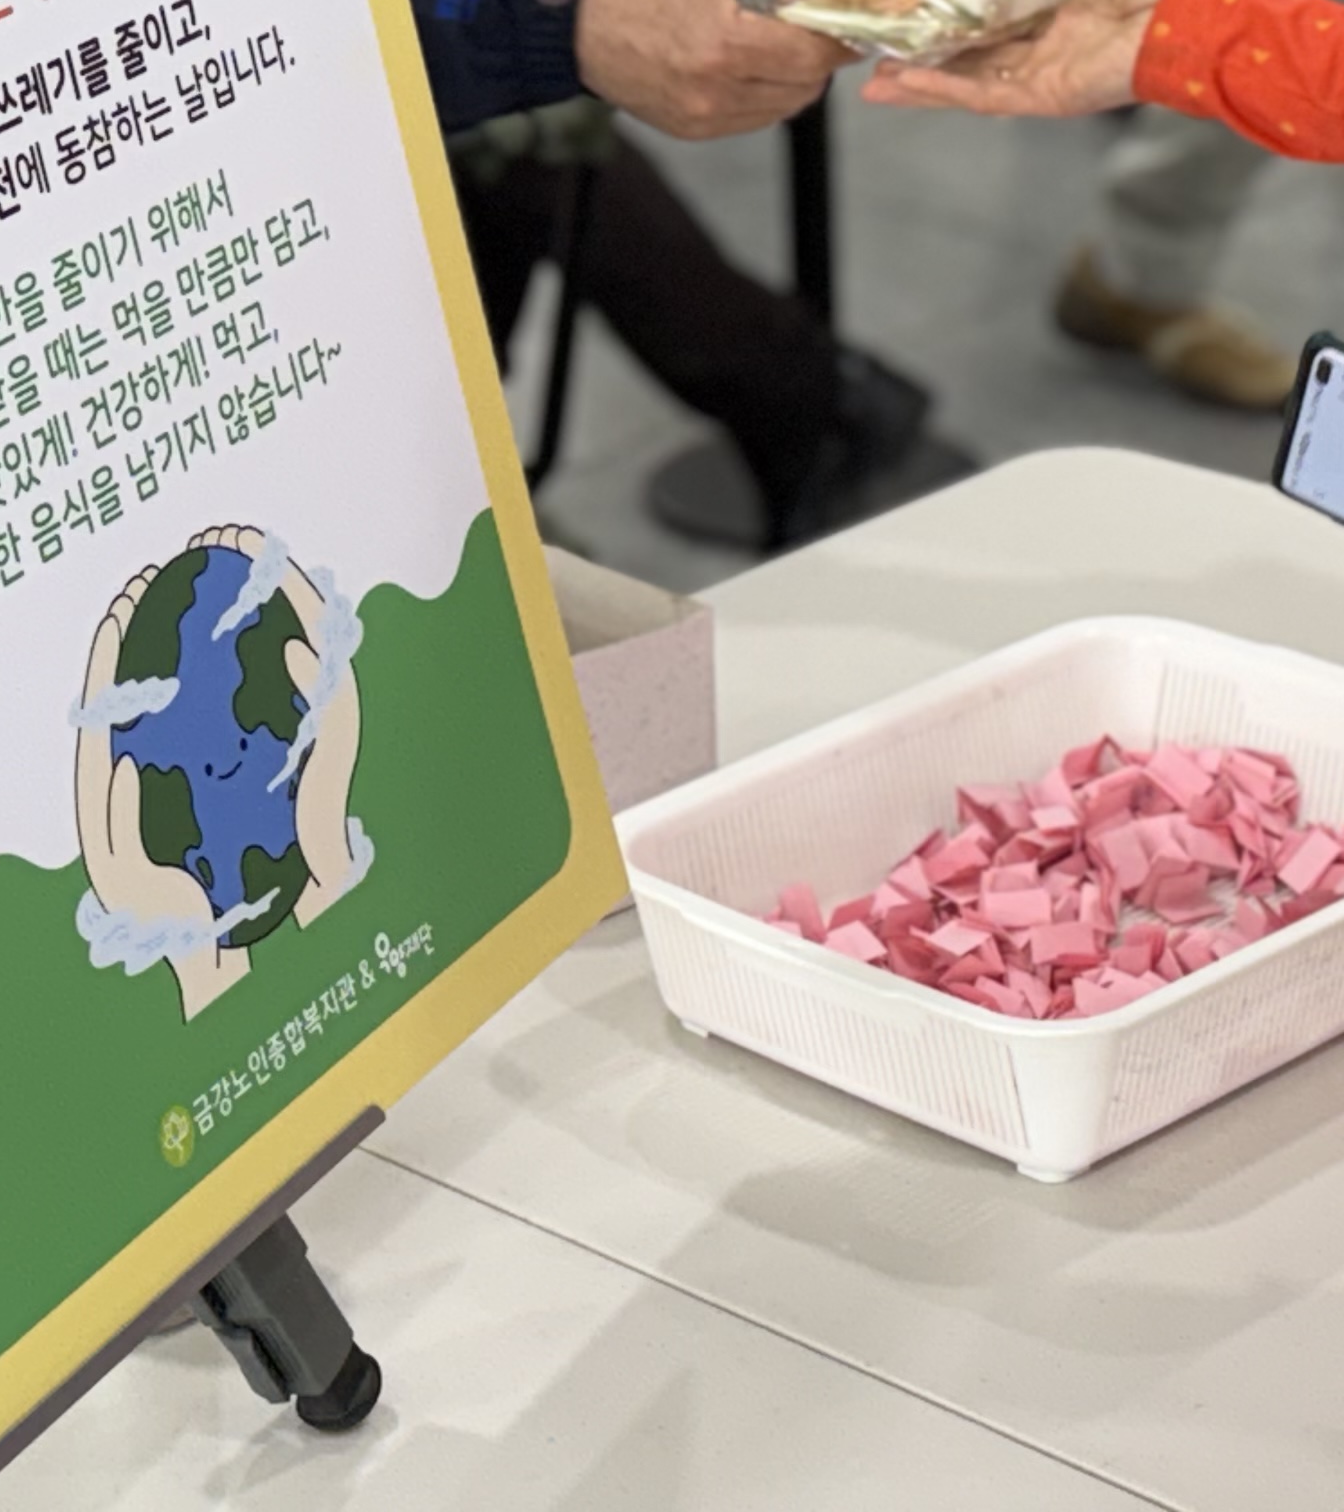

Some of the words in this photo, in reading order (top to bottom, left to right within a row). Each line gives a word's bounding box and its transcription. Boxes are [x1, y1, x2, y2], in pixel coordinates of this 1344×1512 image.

[55, 91, 175, 186] 동참하는
[175, 25, 296, 124] 날입니다.
[47, 324, 108, 395] 때는
[111, 280, 177, 350] 먹을
[176, 228, 263, 319] 만큼만
[265, 198, 331, 270] 담고,
[51, 215, 143, 311] 줄이기
[146, 169, 234, 255] 위해서
[30, 464, 125, 563] 음식을
[125, 405, 216, 503] 남기지
[218, 336, 343, 445] 않습니다~
[80, 342, 212, 451] 건강하게!
[212, 301, 281, 370] 먹고,
[192, 974, 358, 1136] 금강노인종합복지관
[358, 959, 376, 990] &
